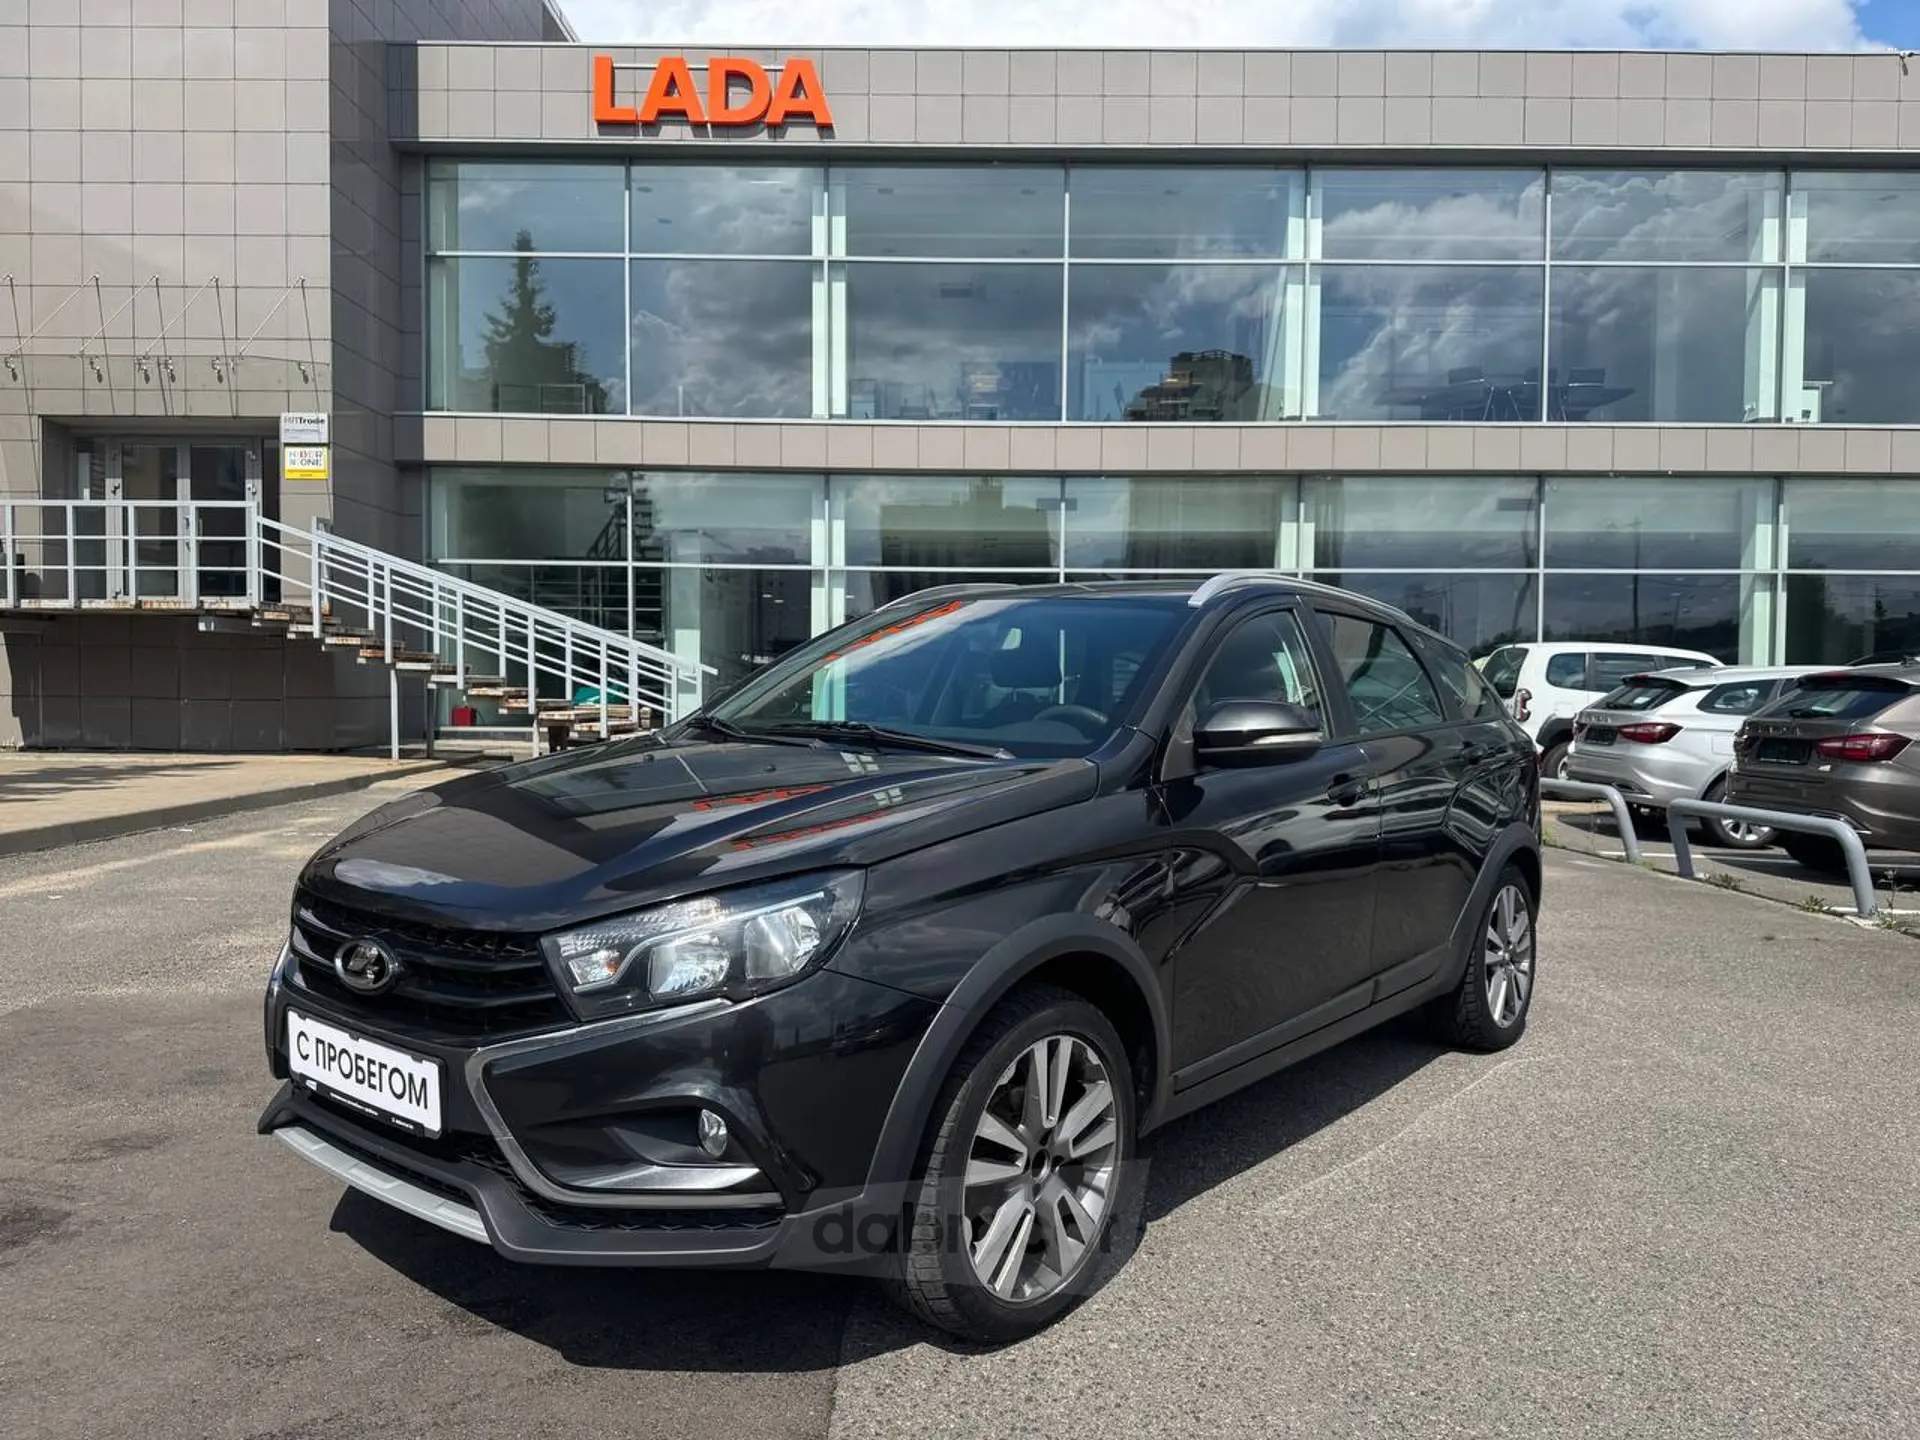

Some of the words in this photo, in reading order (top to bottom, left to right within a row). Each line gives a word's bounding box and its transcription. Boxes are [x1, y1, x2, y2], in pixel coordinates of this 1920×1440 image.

[593, 56, 834, 126] LADA
[296, 1031, 310, 1061] С
[315, 1037, 428, 1110] ПРОБЕГОМ
